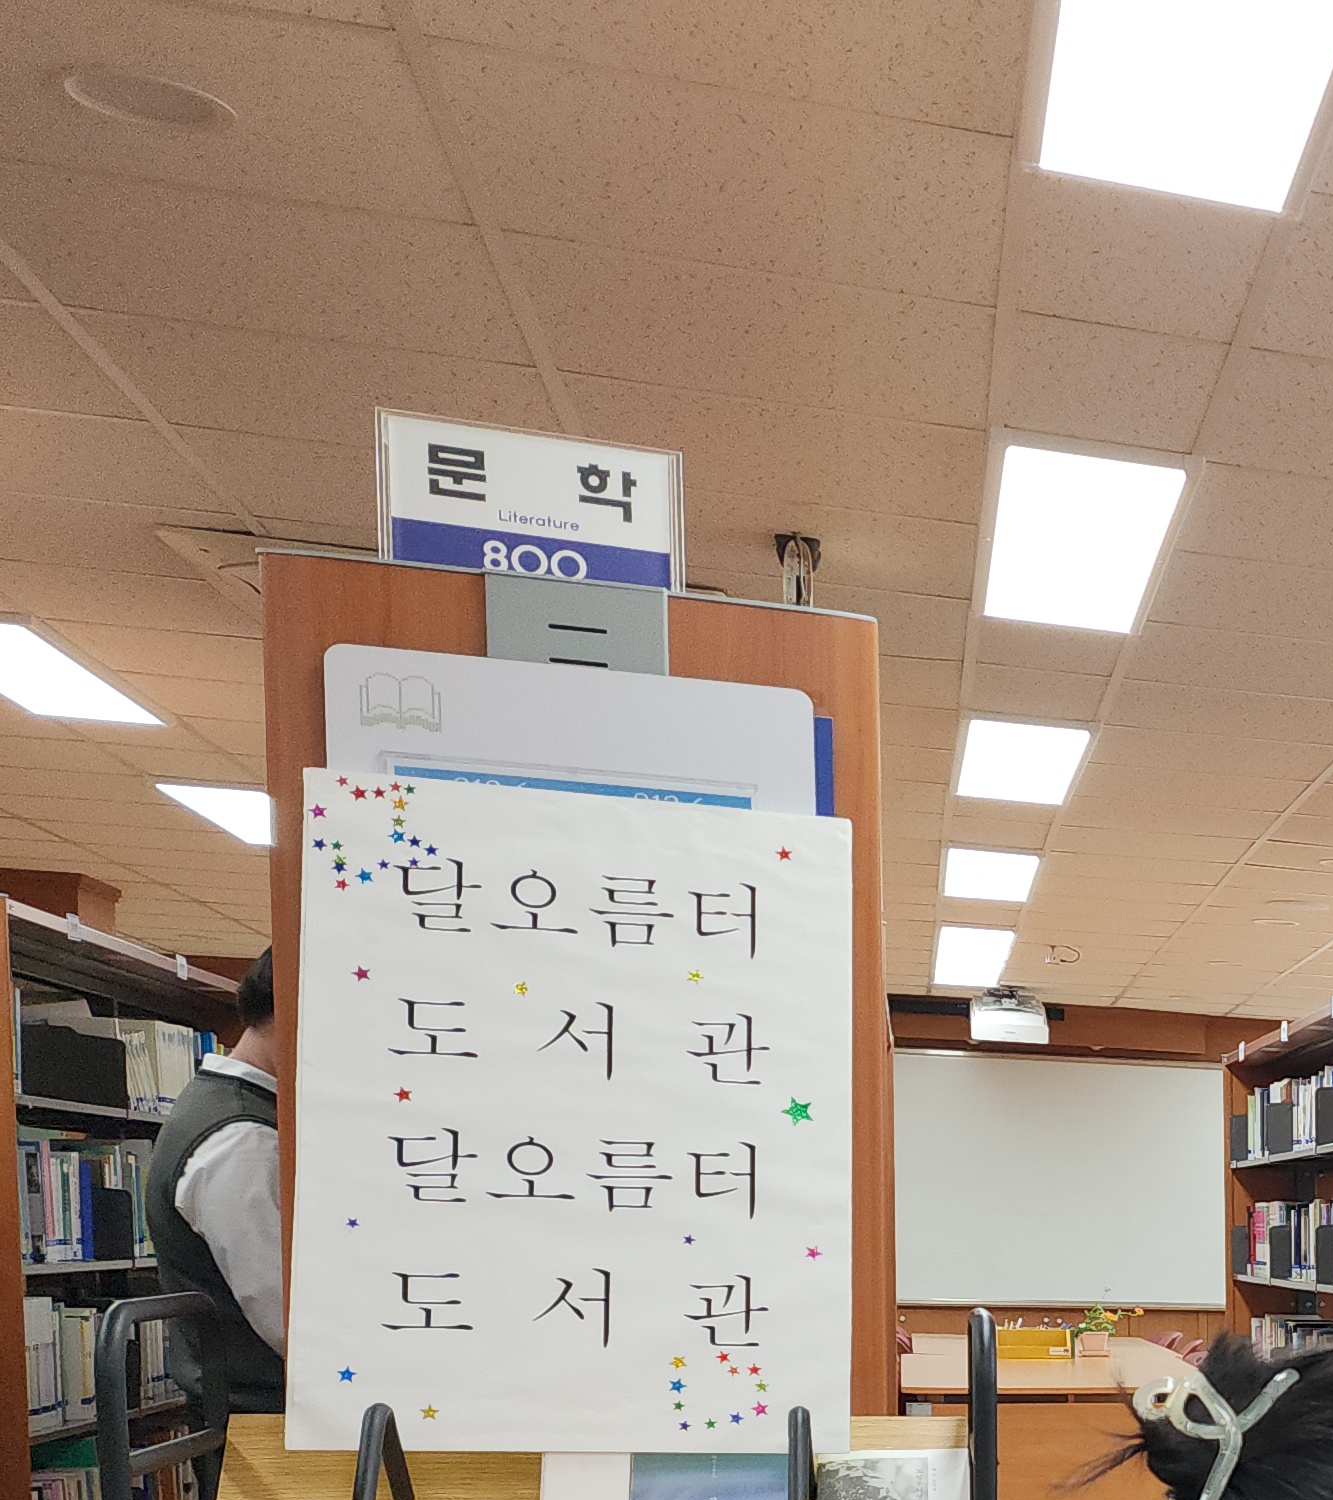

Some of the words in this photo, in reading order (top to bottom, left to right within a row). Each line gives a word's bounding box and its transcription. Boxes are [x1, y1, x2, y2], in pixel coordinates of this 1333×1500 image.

[498, 510, 580, 531] Literature
[483, 539, 588, 581] 800
[393, 857, 757, 960] 달오름터
[386, 1126, 758, 1221] 달오름터
